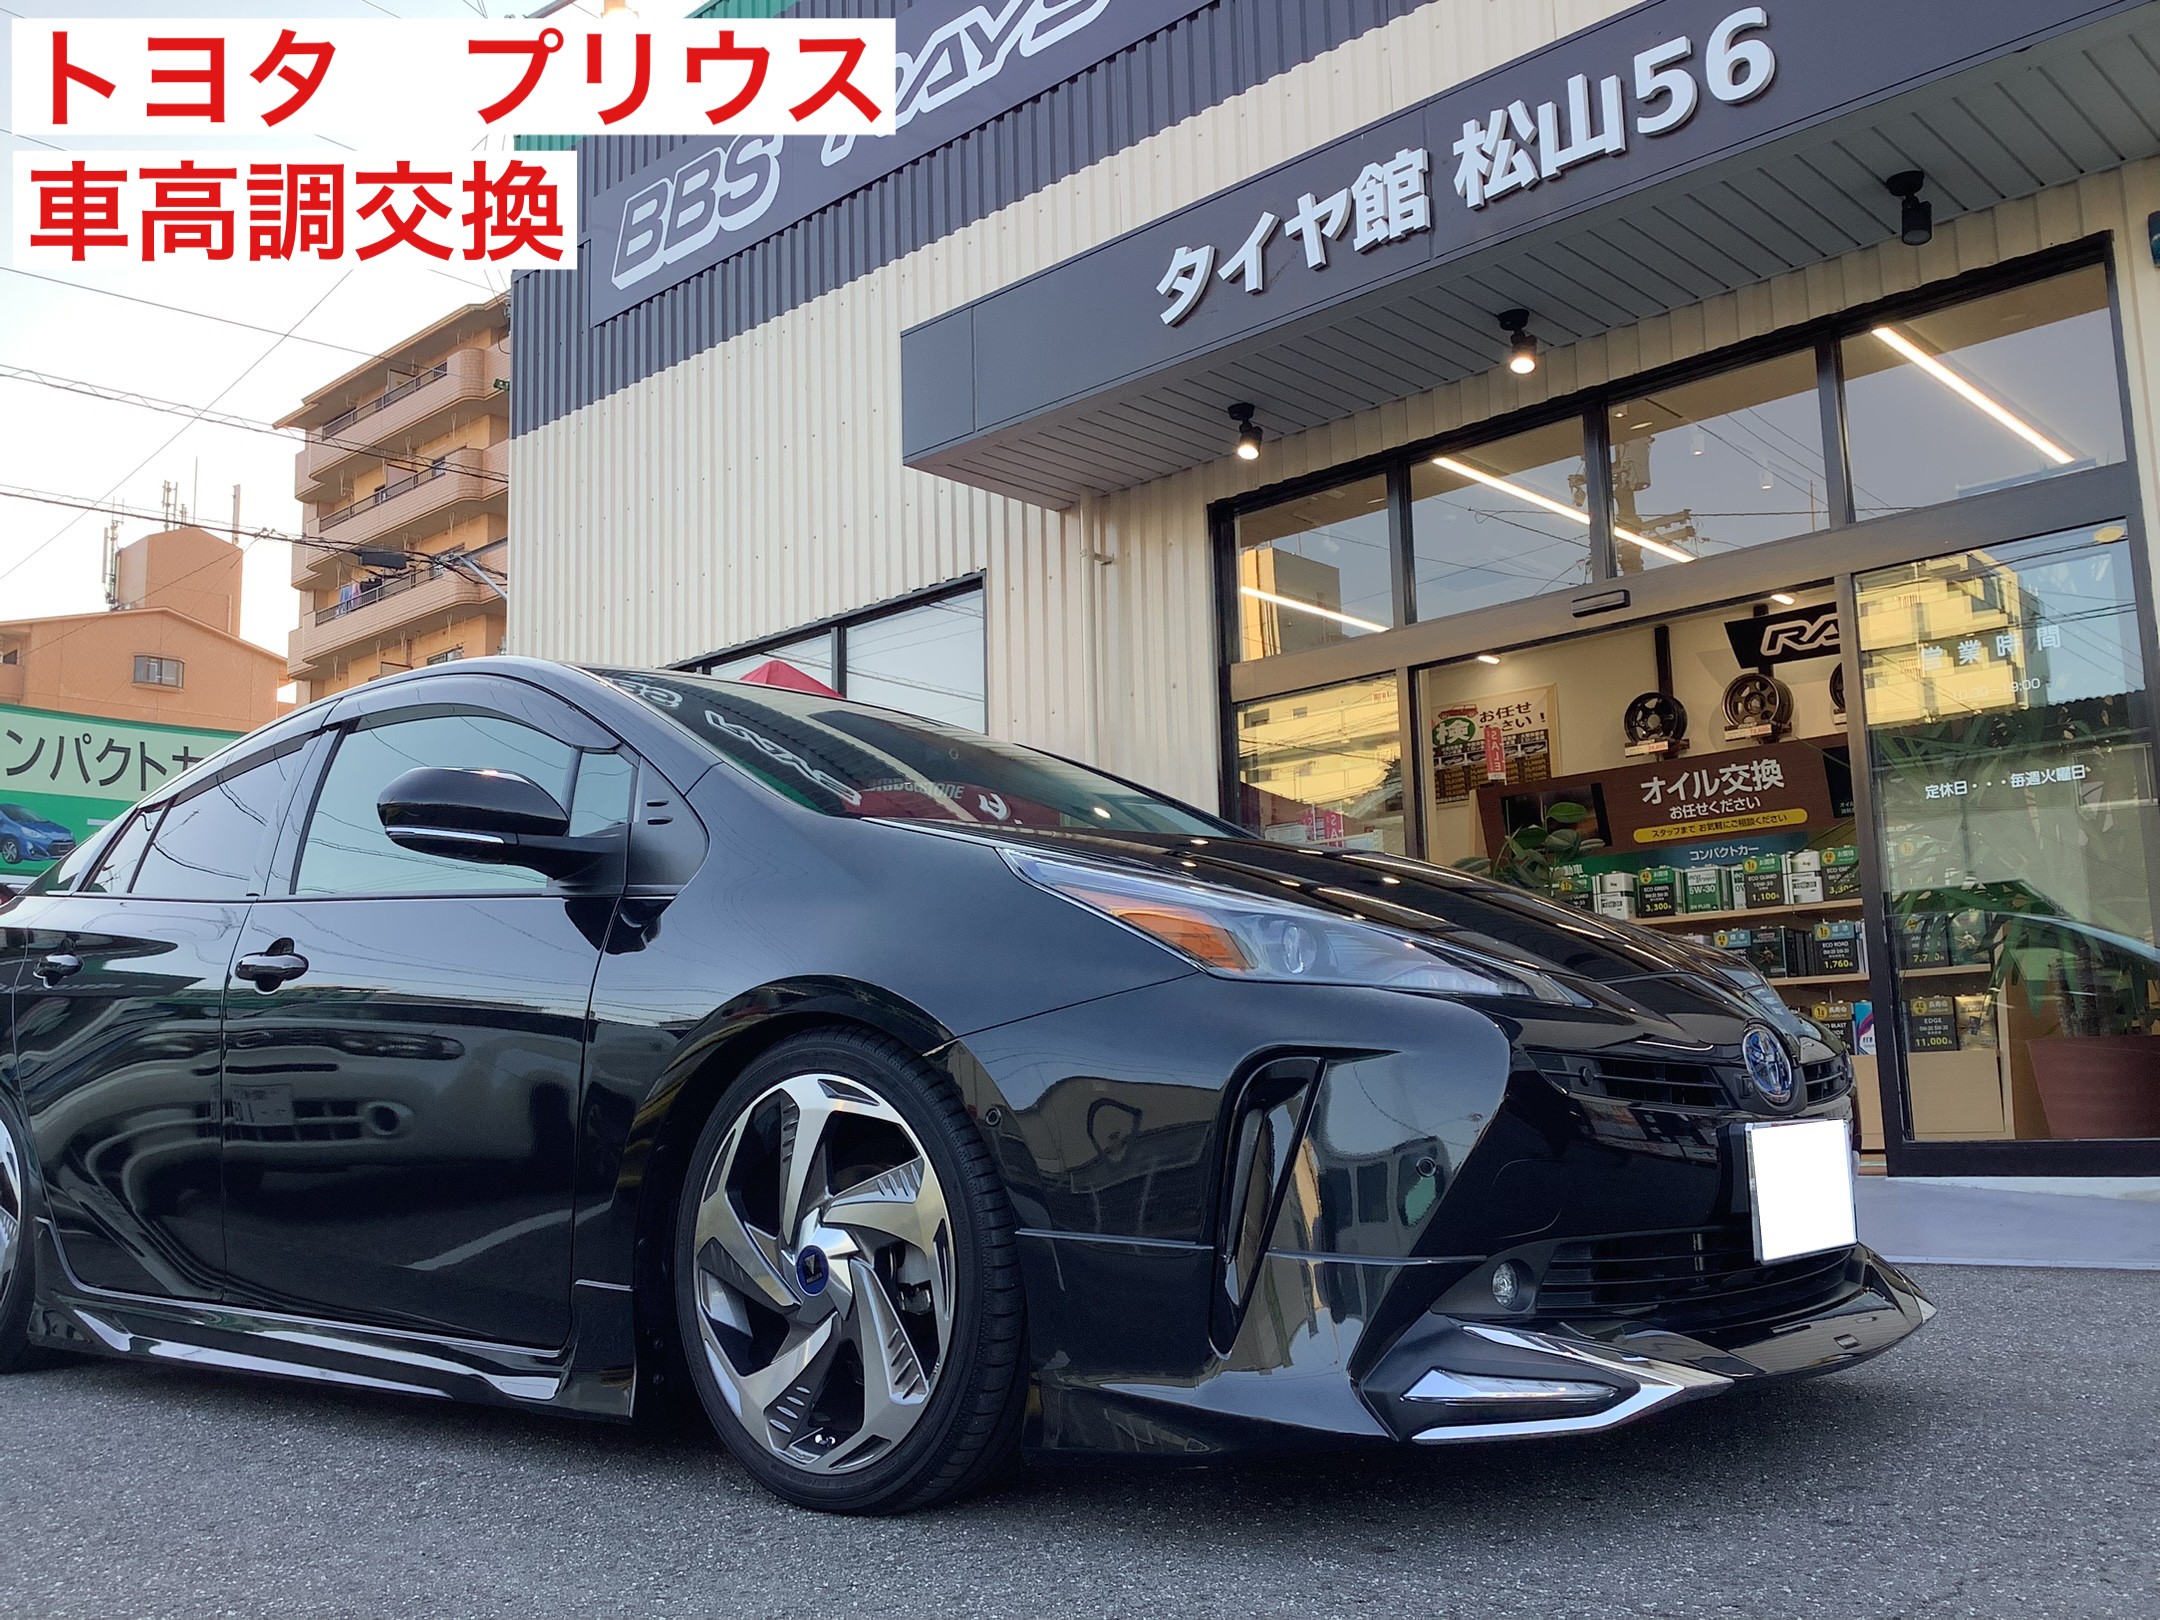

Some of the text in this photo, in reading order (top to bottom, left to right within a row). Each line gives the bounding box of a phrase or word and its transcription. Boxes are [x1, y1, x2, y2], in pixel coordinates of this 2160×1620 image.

[1155, 5, 1777, 327] タイヤ館 松山56
[611, 135, 782, 290] BBS
[1921, 625, 2061, 672] 営業時間
[1480, 702, 1532, 723] お任せ
[1436, 719, 1471, 745] 検
[1640, 758, 1785, 805] オイル交換
[1669, 796, 1761, 820] お任せください
[1652, 814, 1788, 838] スタッフまで お気軽にご相談ください
[1689, 845, 1759, 861] コンパクトカー
[1689, 884, 1716, 895] 5W-30
